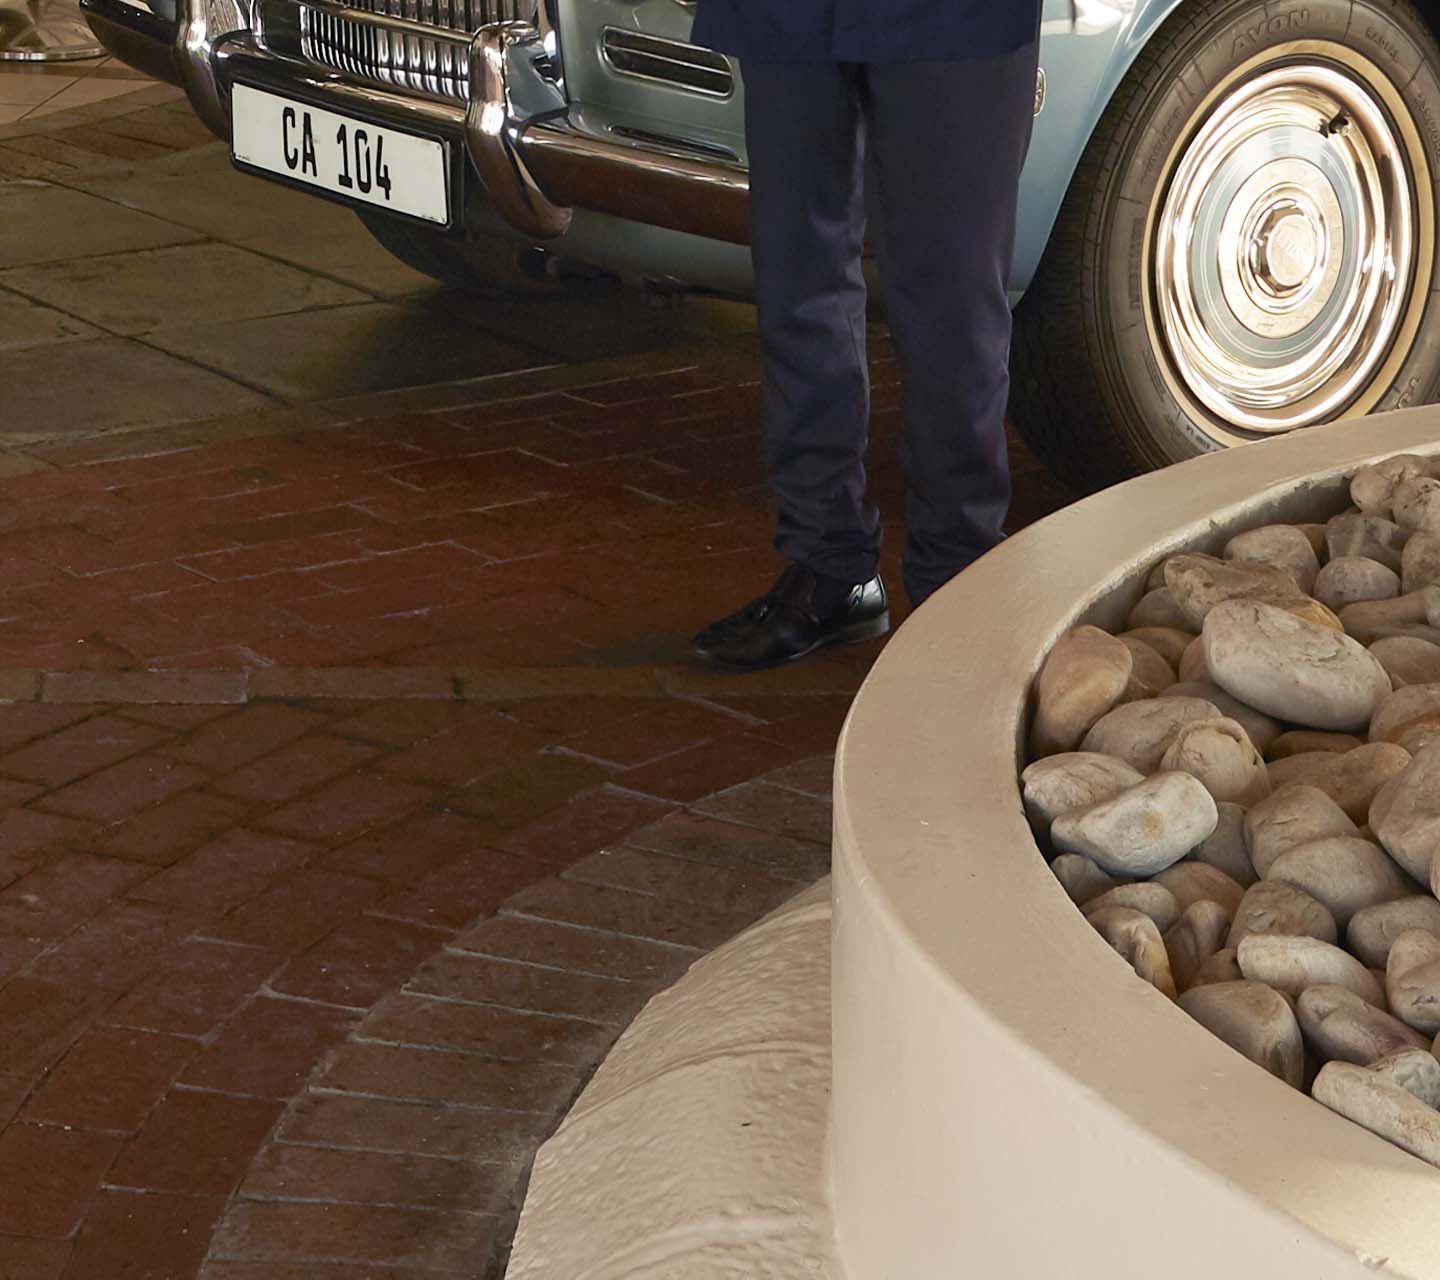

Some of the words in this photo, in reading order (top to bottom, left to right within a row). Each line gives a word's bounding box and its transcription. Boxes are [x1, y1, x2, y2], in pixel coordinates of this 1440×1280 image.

[1231, 7, 1311, 58] AVON
[283, 106, 317, 177] CA
[336, 123, 391, 201] 104
